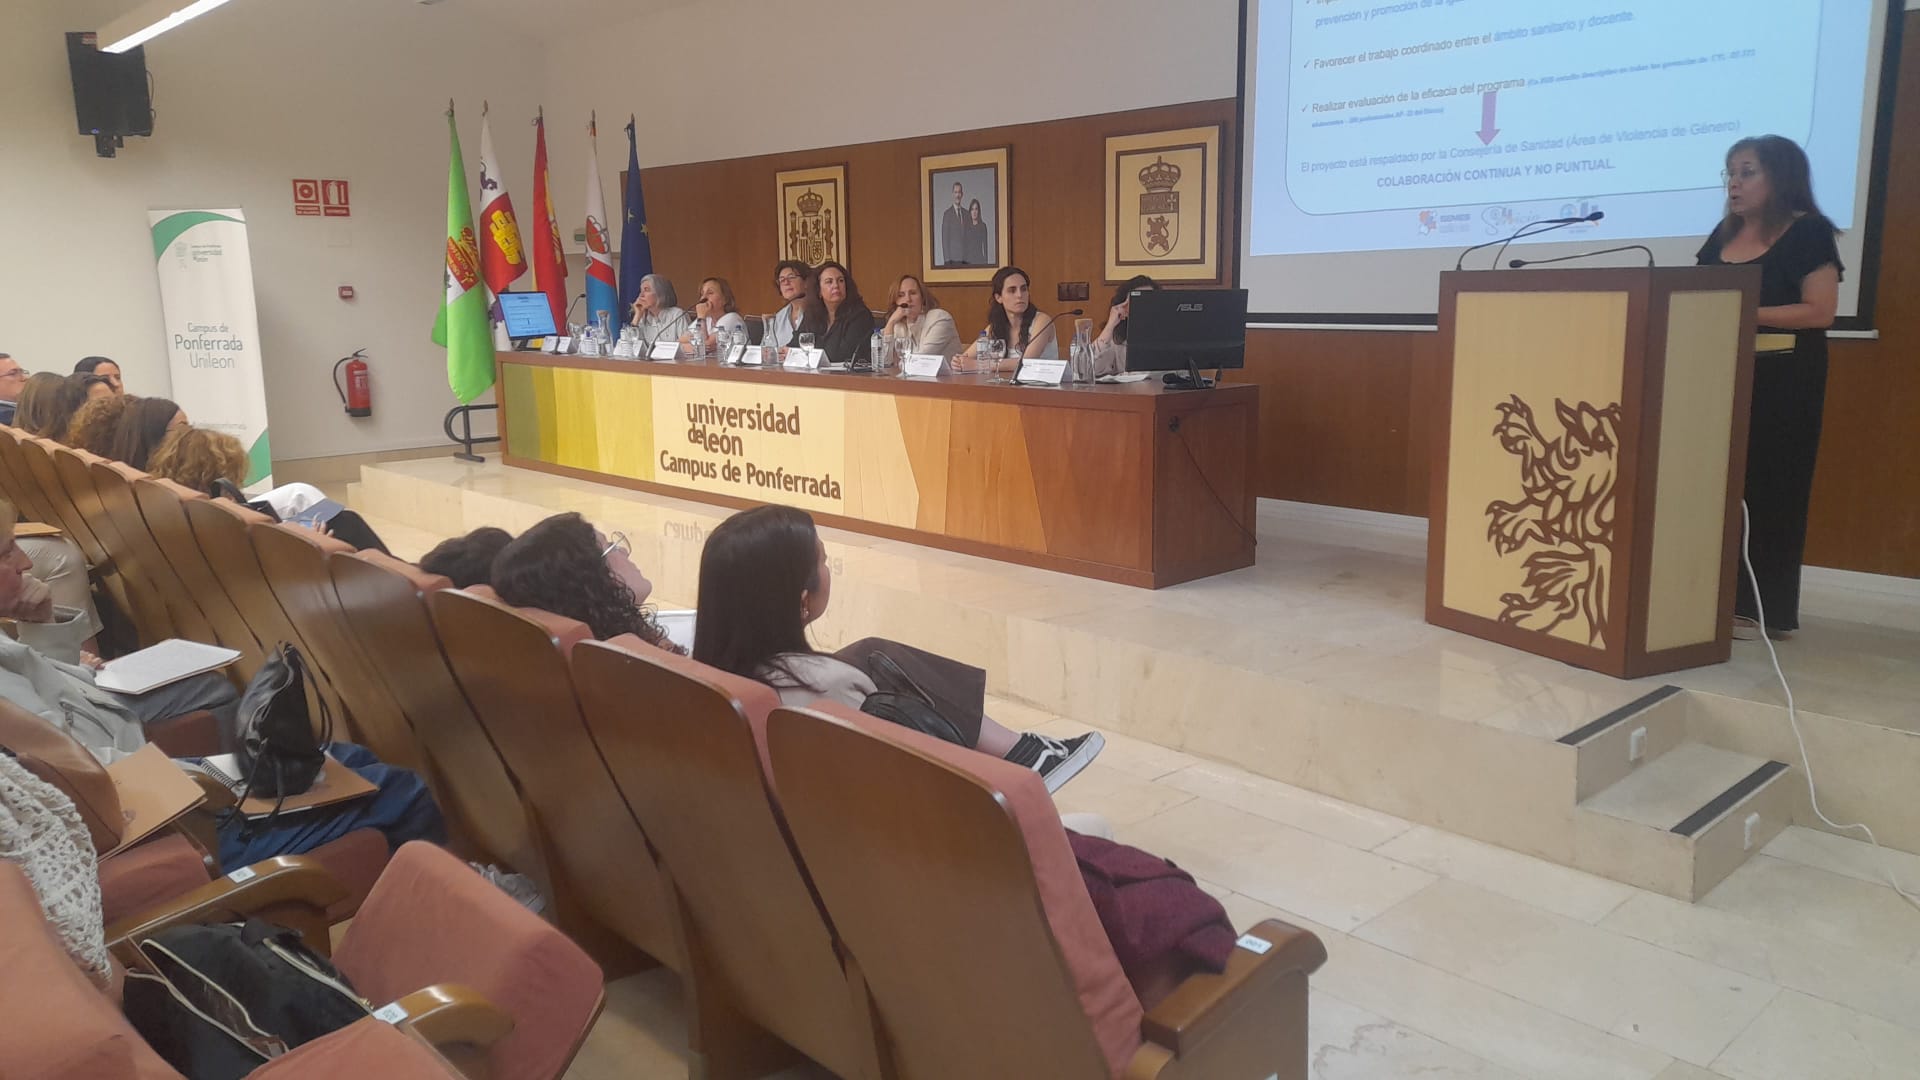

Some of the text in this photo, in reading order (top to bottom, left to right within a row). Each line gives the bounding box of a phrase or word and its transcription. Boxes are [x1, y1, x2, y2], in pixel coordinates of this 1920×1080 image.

[1314, 54, 1356, 69] Favorecer
[1358, 53, 1366, 62] el
[1368, 47, 1399, 61] trabajo
[1401, 39, 1452, 55] coordinado
[1455, 36, 1479, 48] entre
[1482, 33, 1492, 43] el
[1531, 20, 1576, 36] sanitario
[1578, 19, 1585, 31] y
[1312, 77, 1525, 113] Realizar evaluación de la eficacia del programa
[1301, 162, 1309, 172] El
[1311, 160, 1347, 172] proyecto
[1349, 157, 1367, 169] está
[1369, 152, 1419, 167] respaldado
[1421, 152, 1436, 162] por
[1439, 150, 1447, 159] la
[1449, 144, 1502, 159] Consejería
[1505, 142, 1517, 153] de
[1522, 137, 1563, 151] Sanidad
[1599, 133, 1613, 143] de
[1616, 127, 1668, 142] Violencia
[1671, 127, 1686, 138] de
[1690, 120, 1740, 135] Género)
[1377, 170, 1461, 188] COLABORACIÓN
[1463, 166, 1521, 181] CONTINUA
[1525, 164, 1533, 176] Y
[1535, 163, 1552, 175] NO
[1176, 303, 1204, 312] ASUS
[175, 334, 243, 351] Ponferrada
[187, 322, 229, 335] Campus de
[190, 351, 235, 369] Unileon
[686, 398, 801, 436] universidad
[687, 422, 744, 457] de león
[660, 449, 841, 500] Campus de Ponferrada
